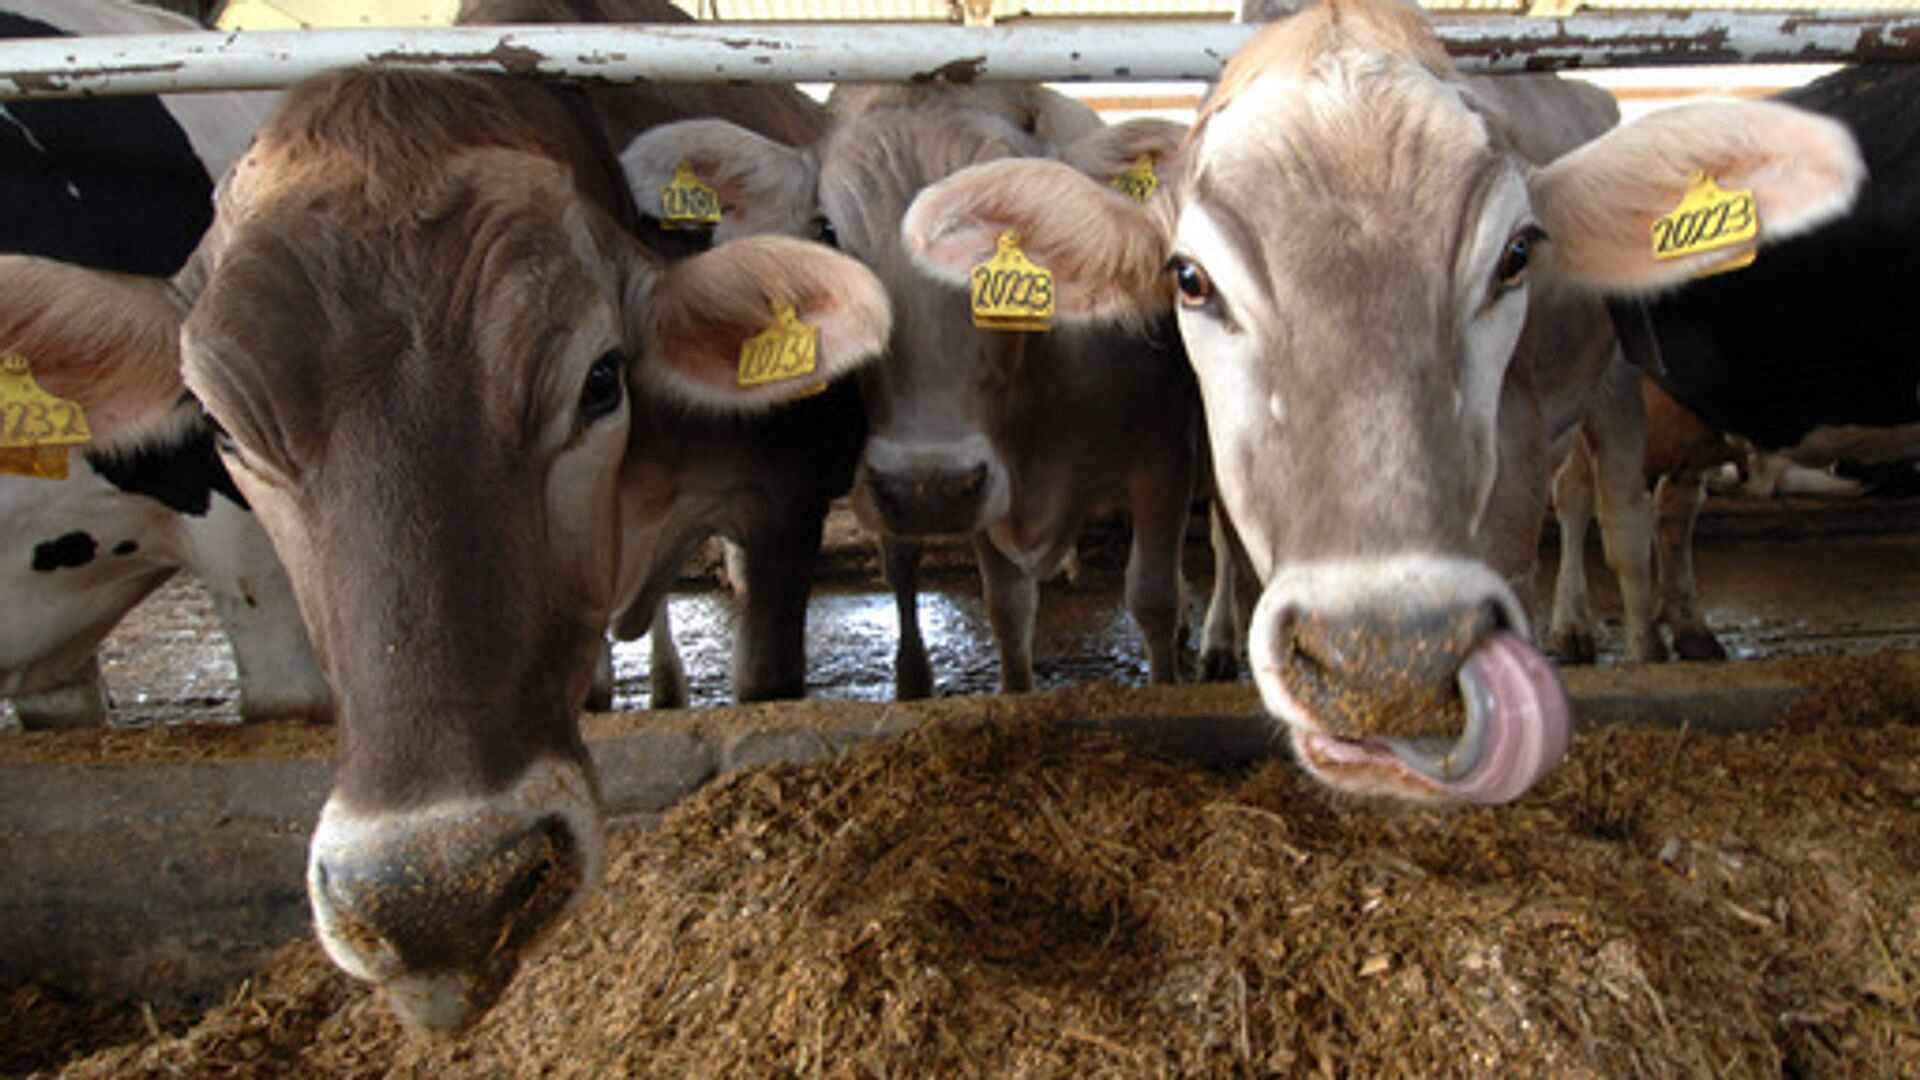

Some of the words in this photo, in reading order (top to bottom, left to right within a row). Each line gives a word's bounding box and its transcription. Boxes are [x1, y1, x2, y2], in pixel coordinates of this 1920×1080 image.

[1653, 197, 1752, 252] 20223
[974, 266, 1052, 311] 20223
[0, 401, 87, 440] 232
